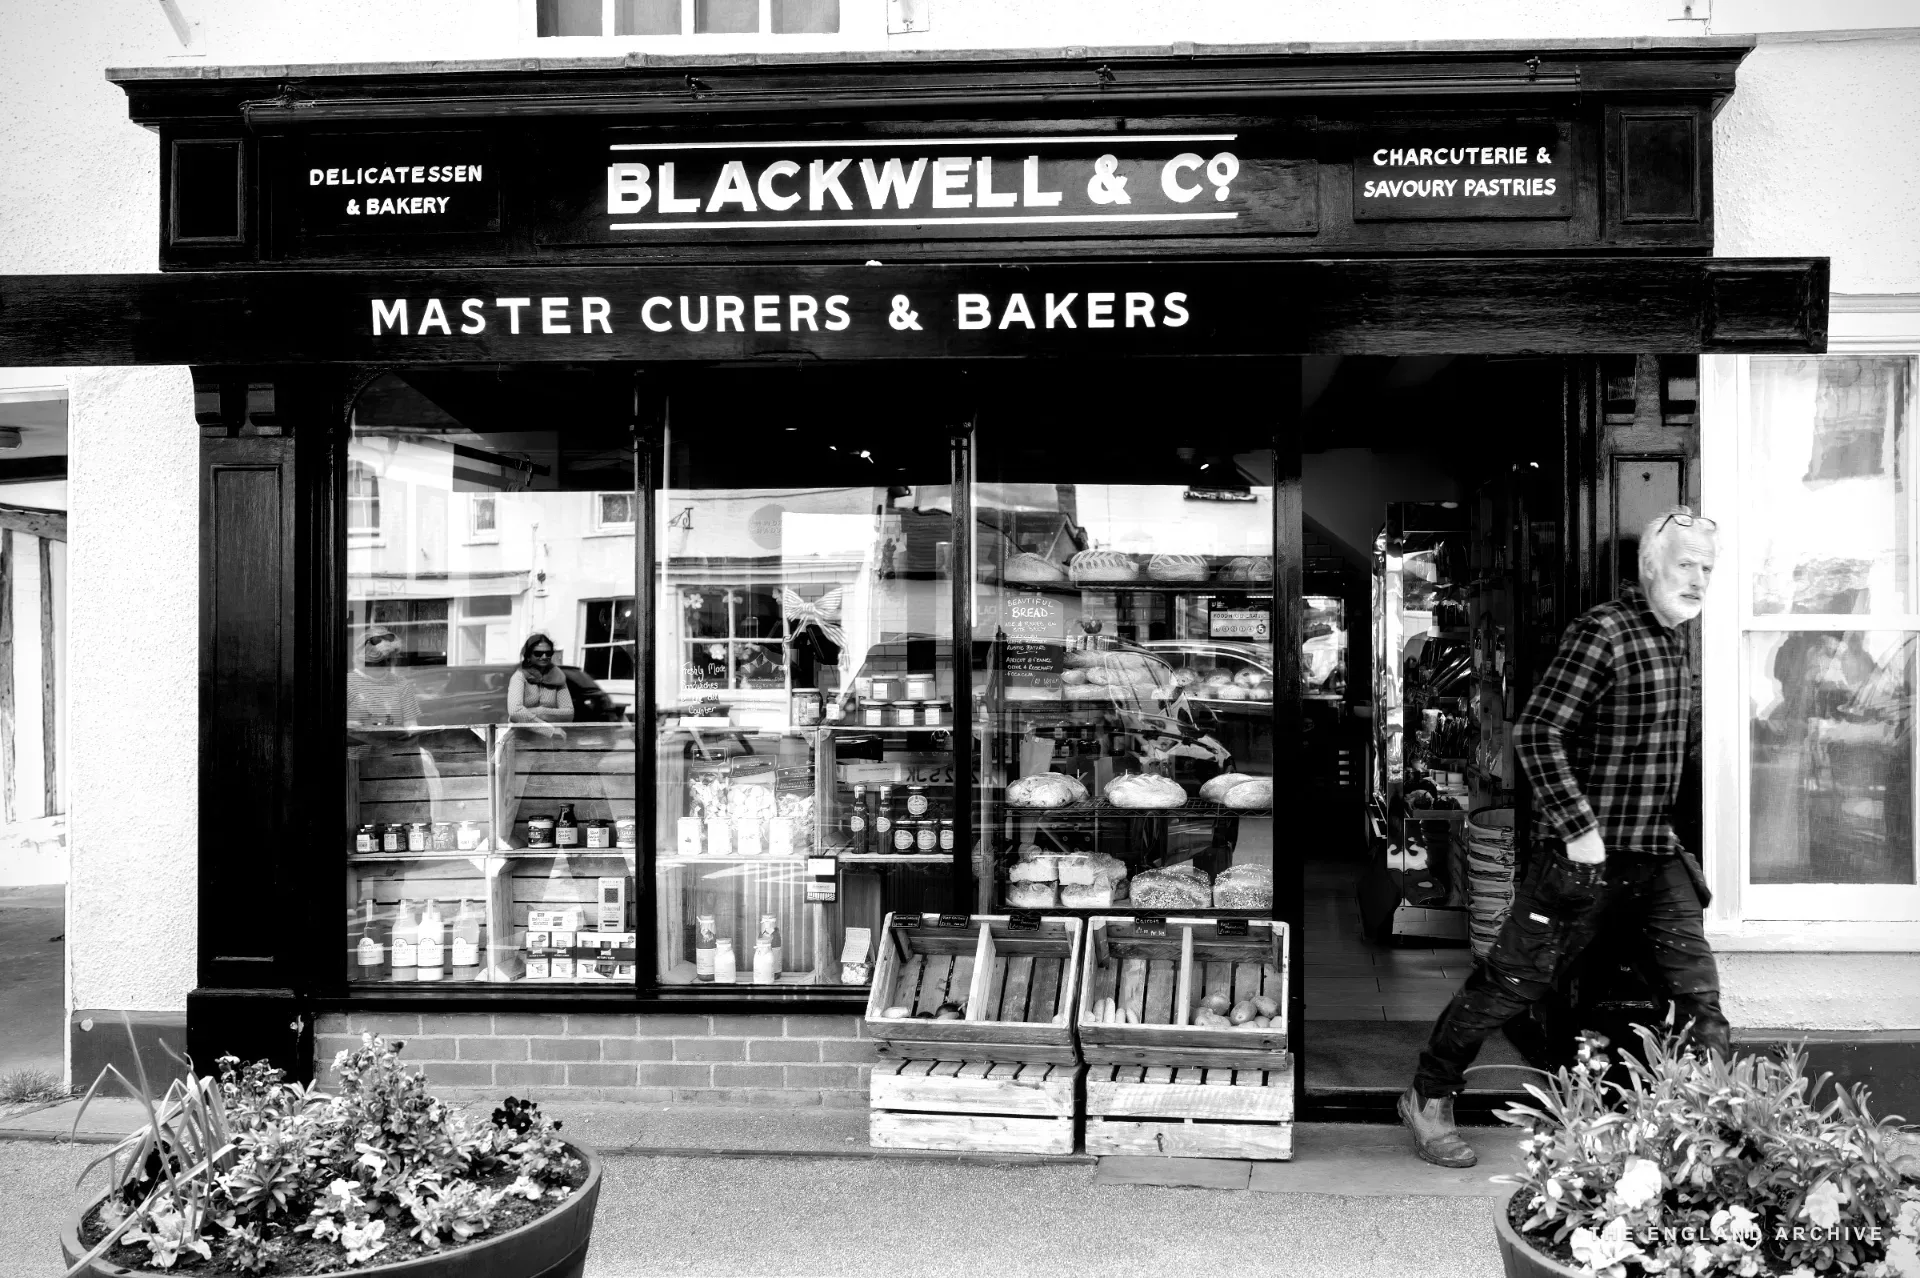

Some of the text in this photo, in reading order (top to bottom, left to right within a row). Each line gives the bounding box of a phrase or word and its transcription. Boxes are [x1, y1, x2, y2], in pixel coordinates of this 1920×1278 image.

[1373, 146, 1552, 166] CHARCUTERIE &
[309, 165, 482, 186] DELICATESSEN
[607, 154, 1063, 214] BLACKWELL
[1086, 153, 1132, 205] &
[1363, 177, 1557, 198] SAVOURY PASTRIES
[346, 197, 451, 215] & BAKERY
[371, 292, 1190, 336] MASTER CURERS & BAKERS
[1007, 598, 1054, 608] BEAUTIFUL
[1012, 607, 1048, 618] BREAD
[688, 705, 717, 718] Counter
